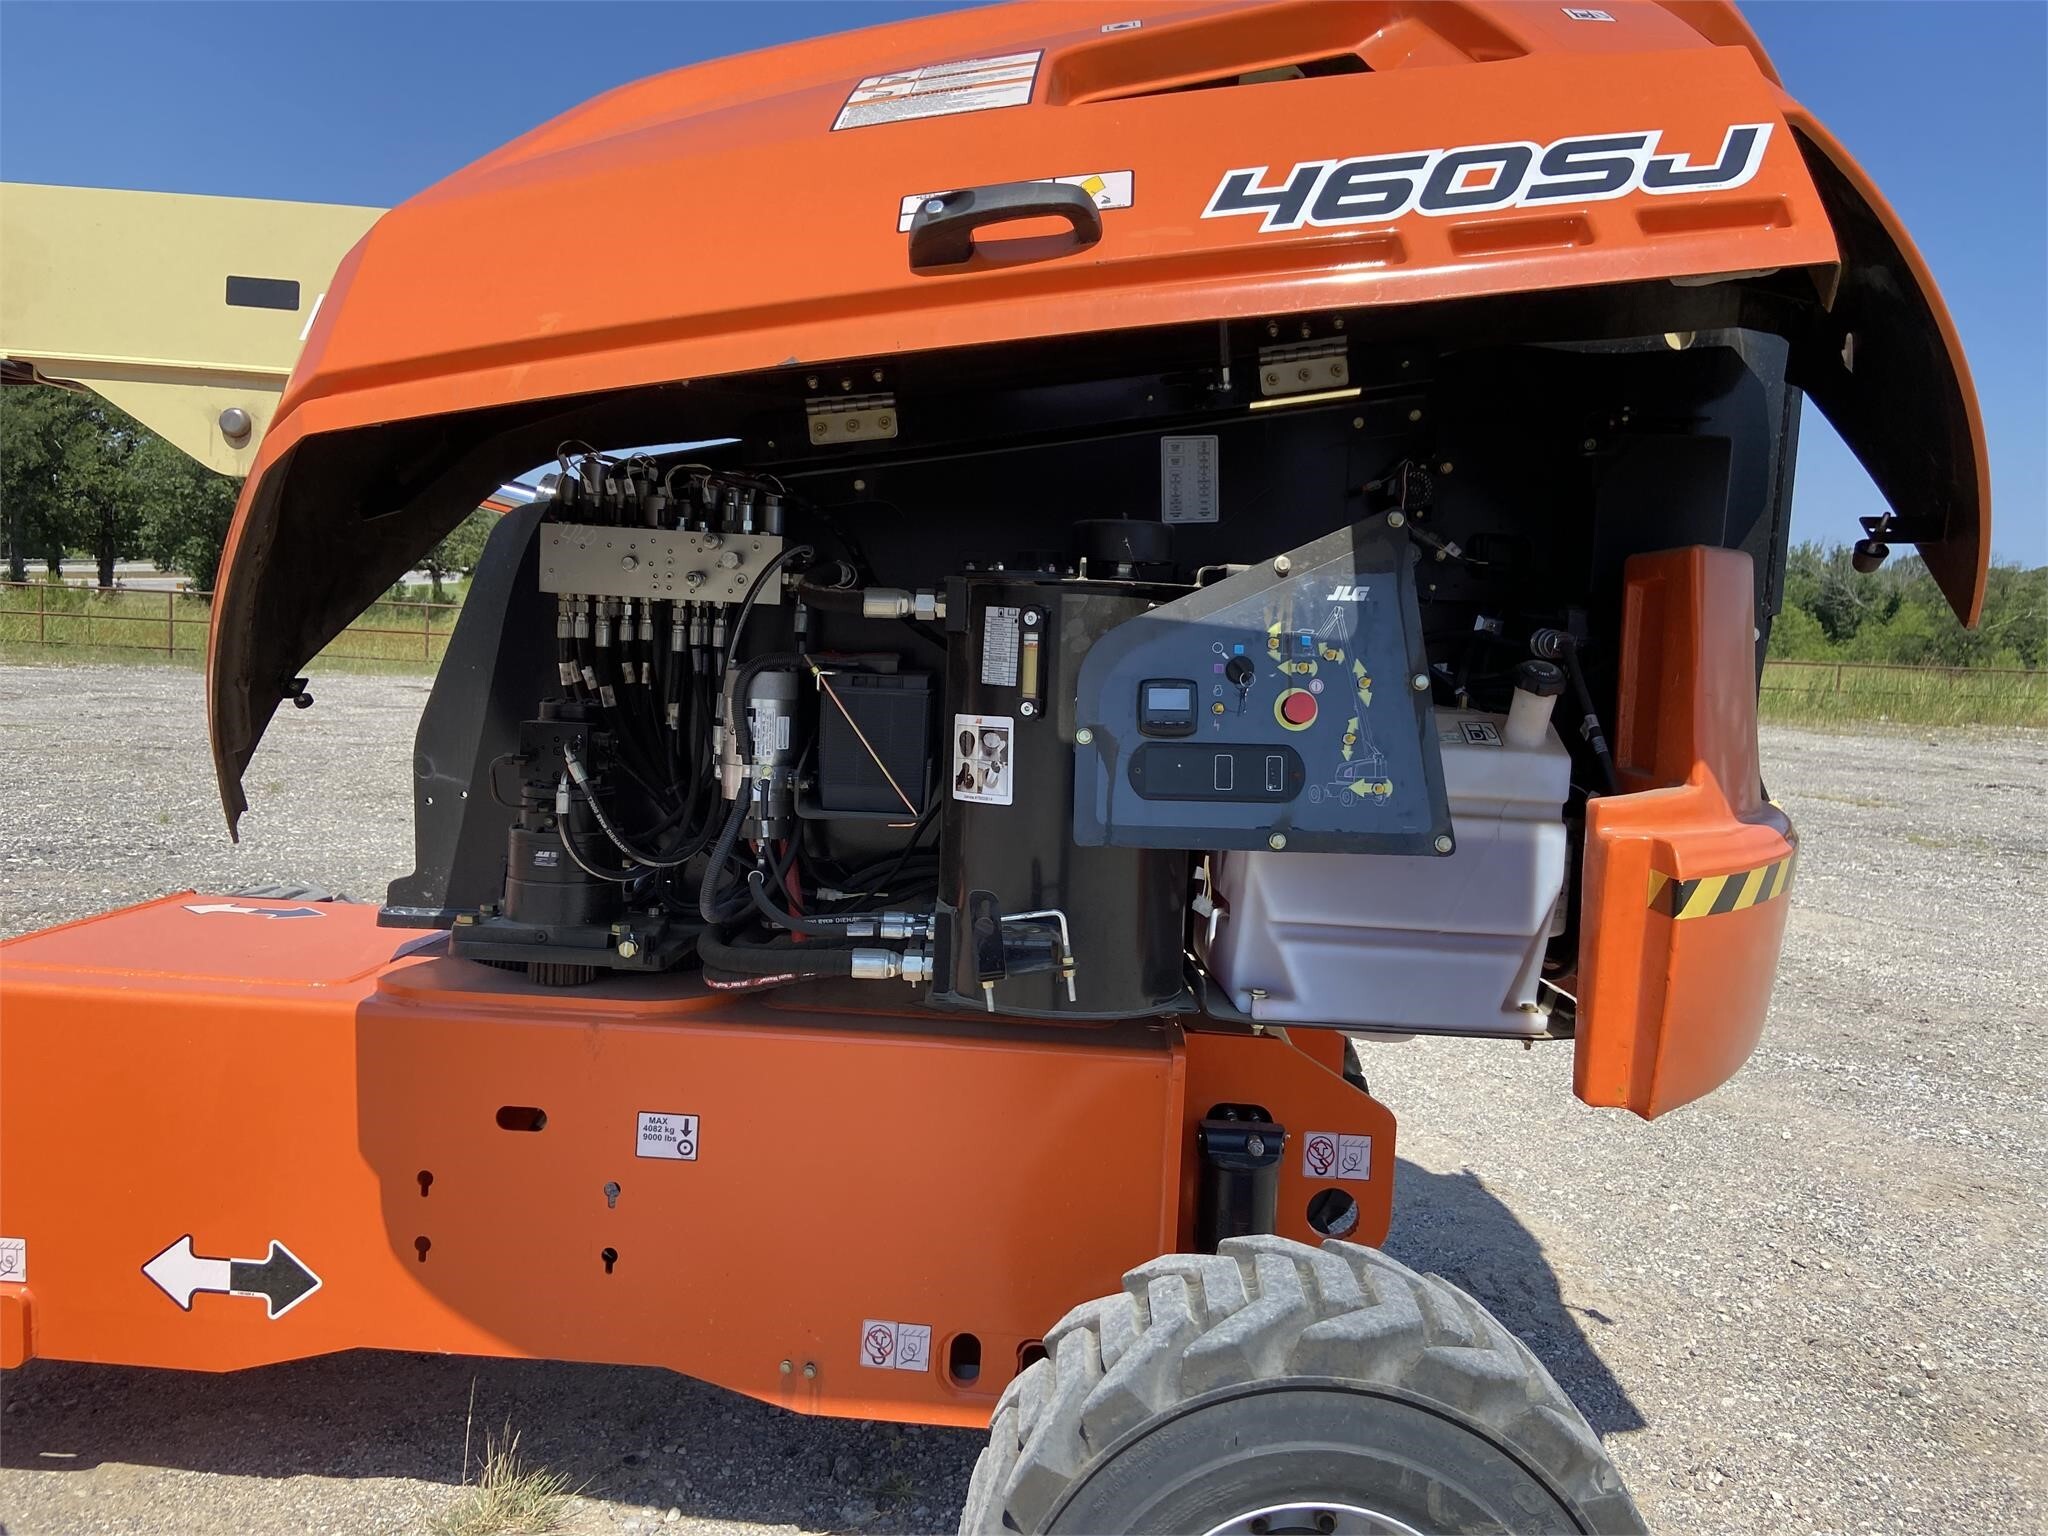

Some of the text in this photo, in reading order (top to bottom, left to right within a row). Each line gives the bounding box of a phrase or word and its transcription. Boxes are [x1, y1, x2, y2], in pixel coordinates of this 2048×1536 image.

[1200, 122, 1774, 232] 460SJ
[1326, 585, 1370, 602] JLG
[648, 1116, 668, 1125] MAX
[642, 1124, 675, 1135] 4082 kg
[642, 1133, 677, 1142] 9000 lbs
